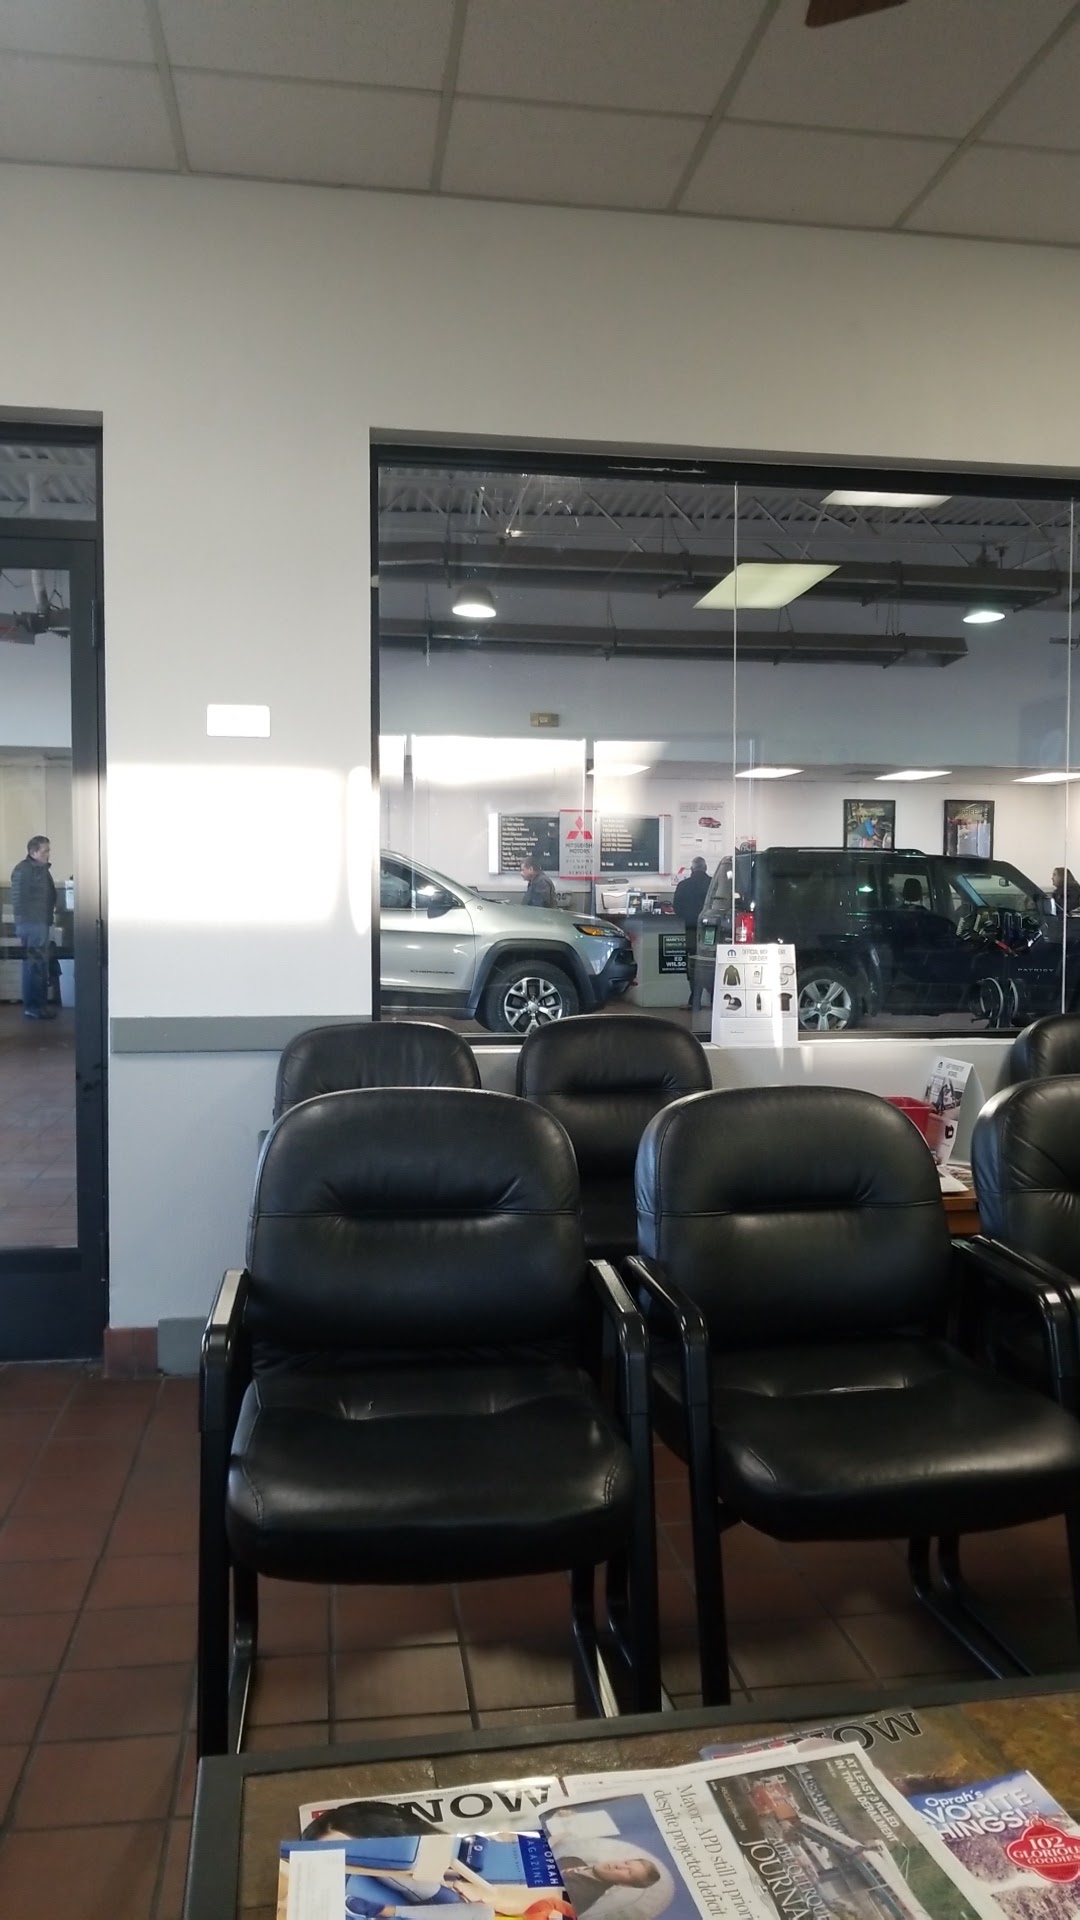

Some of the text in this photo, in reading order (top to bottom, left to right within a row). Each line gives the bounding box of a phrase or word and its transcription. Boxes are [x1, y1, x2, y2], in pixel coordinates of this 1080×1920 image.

[398, 1784, 551, 1824] NOW
[834, 1759, 900, 1842] IN TRAIN DERAILMENT
[844, 1758, 858, 1769] AT
[852, 1770, 876, 1796] LEAST
[874, 1802, 900, 1828] KILLED
[925, 1789, 984, 1809] Oprah's
[934, 1807, 1030, 1840] HINGS!
[653, 1789, 727, 1917] despite projected deficit
[696, 1827, 723, 1854] APD
[1012, 1844, 1080, 1859] GLORIOU
[1029, 1836, 1065, 1850] 102
[526, 1836, 543, 1885] AGAZINE
[544, 1851, 559, 1885] OPRAH
[712, 1856, 737, 1877] still
[722, 1880, 735, 1888] a
[739, 1839, 810, 1920] JOURNA
